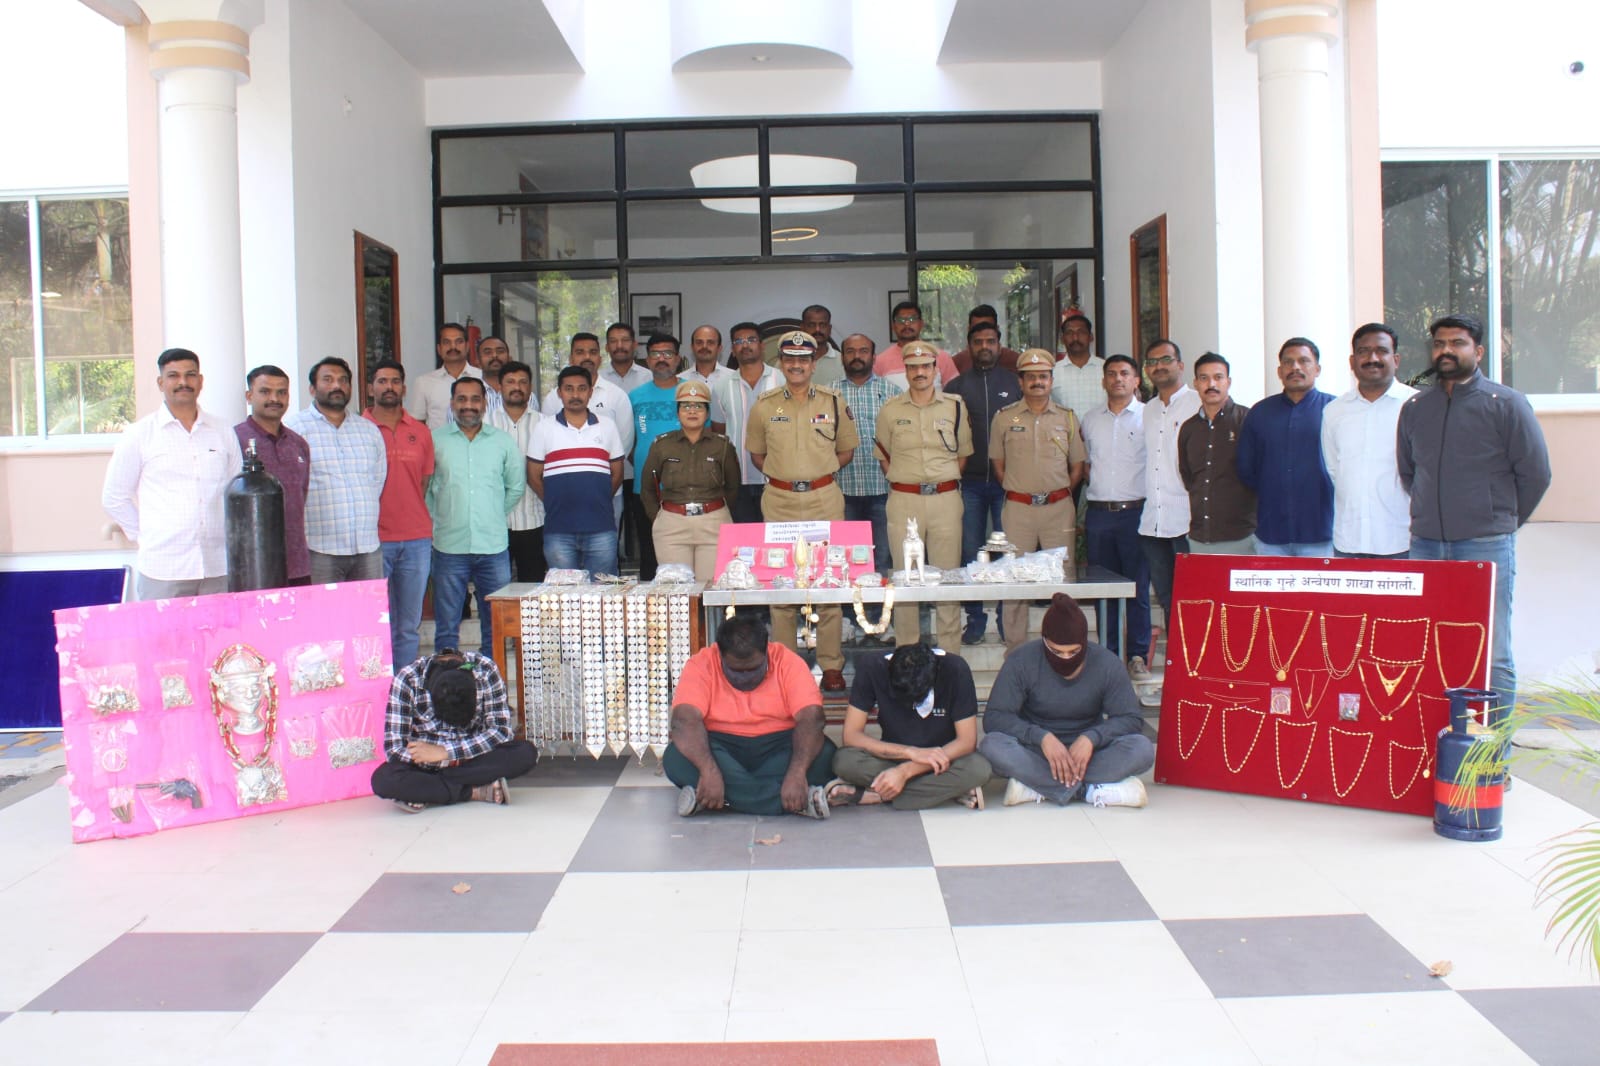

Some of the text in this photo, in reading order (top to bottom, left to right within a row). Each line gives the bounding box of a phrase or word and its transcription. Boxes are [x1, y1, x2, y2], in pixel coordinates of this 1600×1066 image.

[1234, 573, 1417, 591] स्थानिक गुन्हे अन्वेषण शाखा सांगली.
